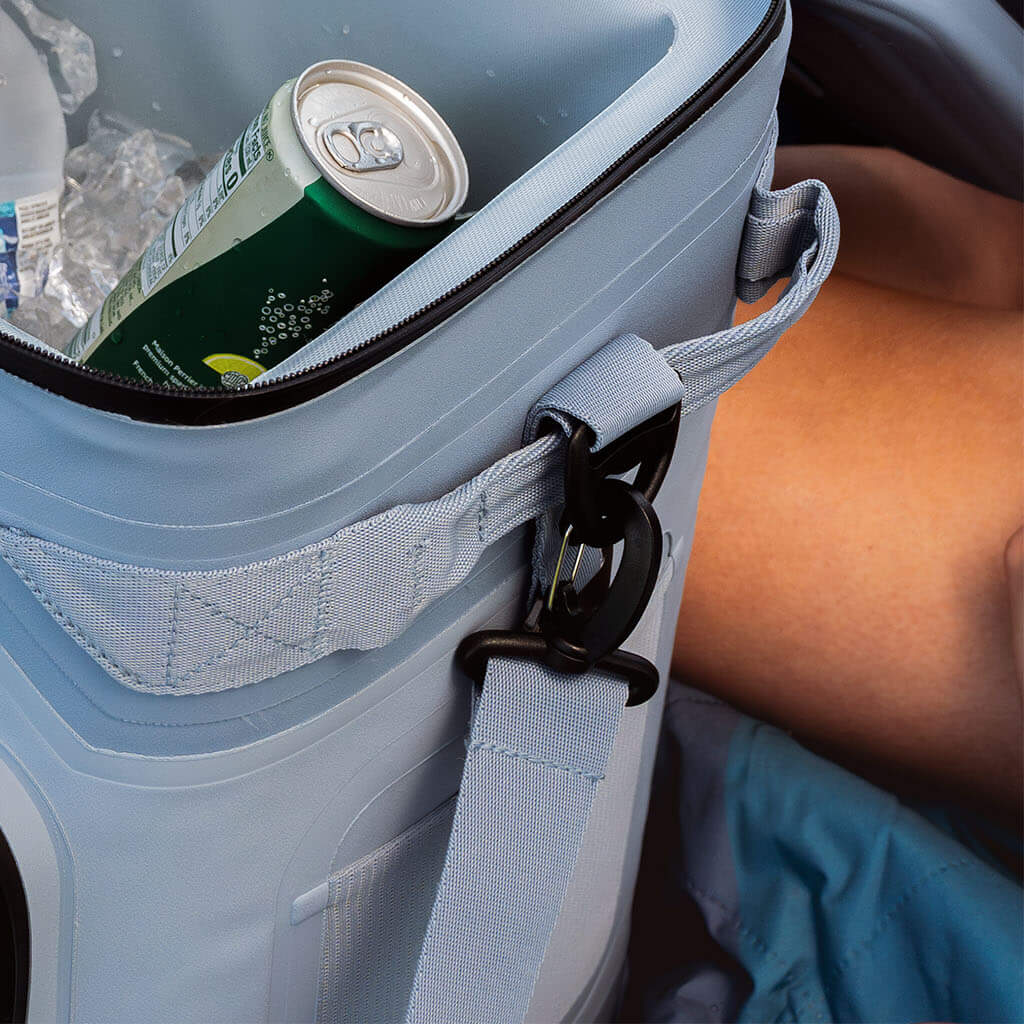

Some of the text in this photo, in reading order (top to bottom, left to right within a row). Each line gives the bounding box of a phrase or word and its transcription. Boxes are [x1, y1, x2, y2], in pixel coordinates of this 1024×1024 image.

[142, 343, 170, 376] premium
[151, 339, 174, 367] Maison
[173, 364, 198, 386] Perrier
